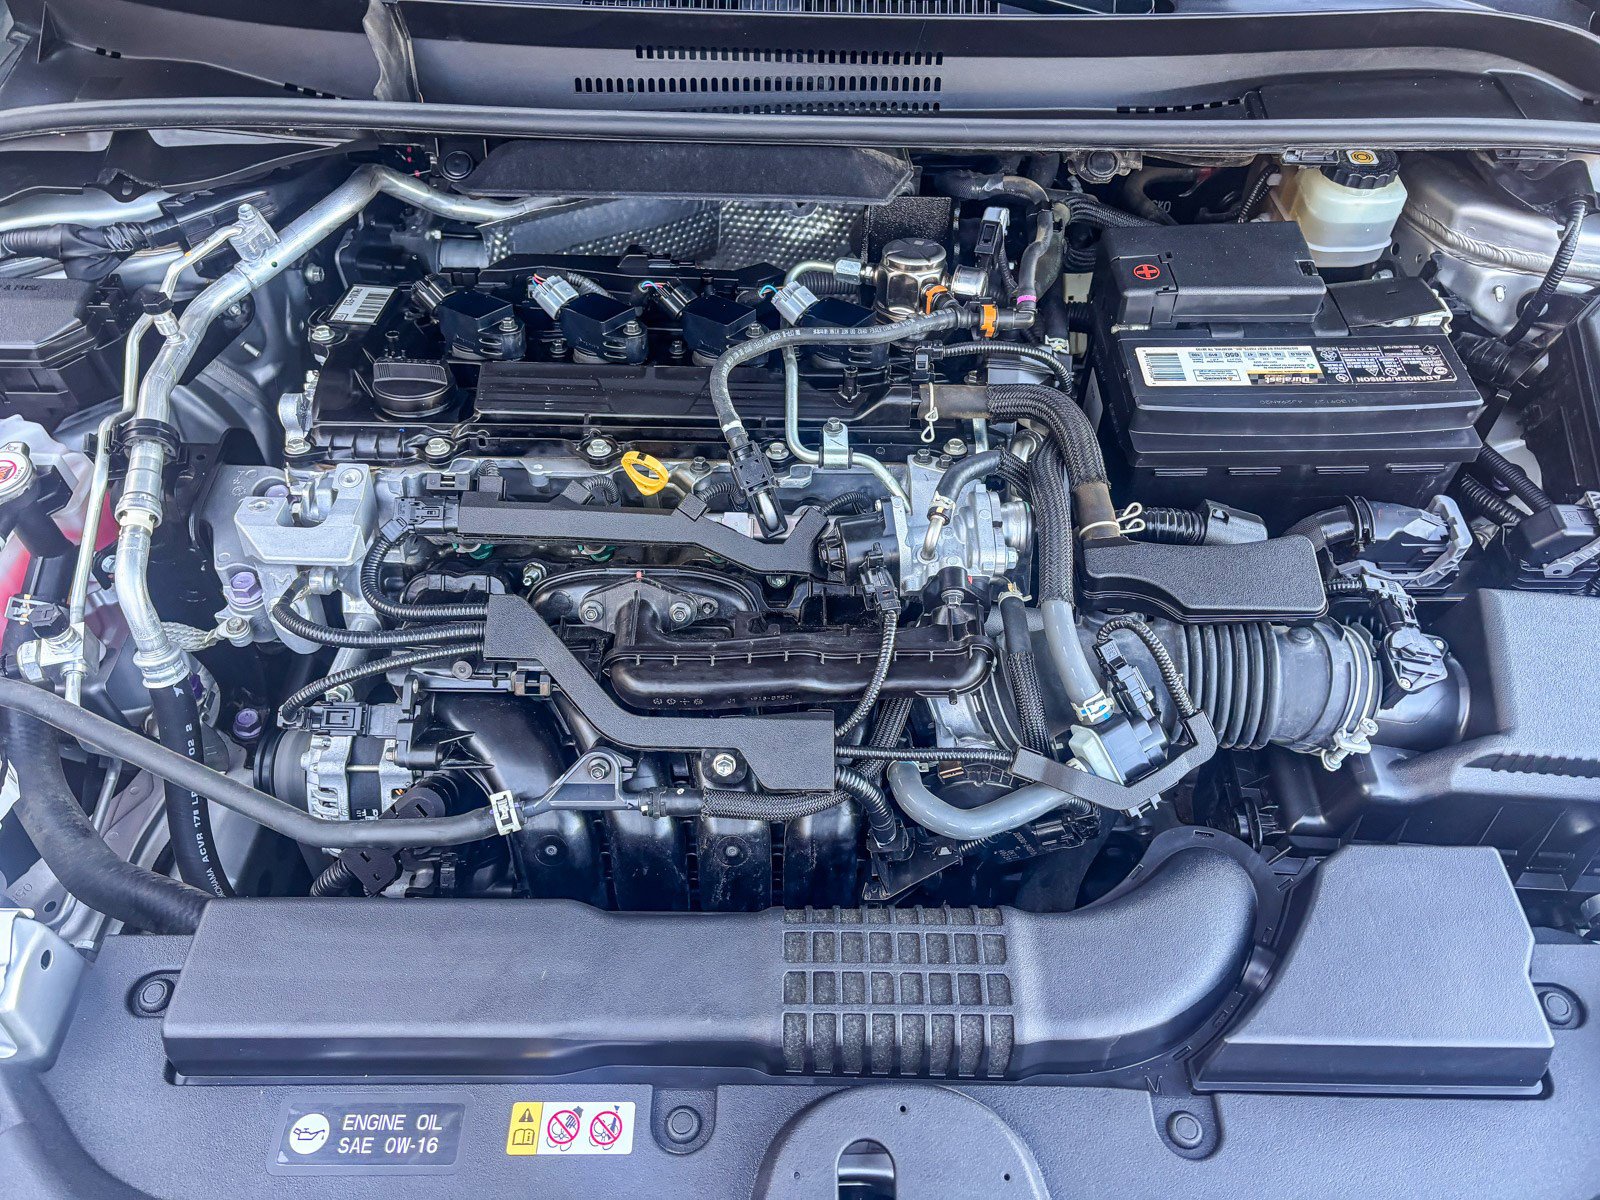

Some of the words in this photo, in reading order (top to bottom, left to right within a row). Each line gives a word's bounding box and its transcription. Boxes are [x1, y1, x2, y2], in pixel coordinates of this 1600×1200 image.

[1264, 376, 1310, 384] Duralast
[1356, 374, 1434, 383] DANGER/POISON
[196, 832, 210, 863] ACVR
[342, 1114, 407, 1131] ENGINE
[416, 1114, 443, 1131] OIL
[337, 1136, 375, 1154] SAE
[384, 1136, 439, 1154] 0W-16
